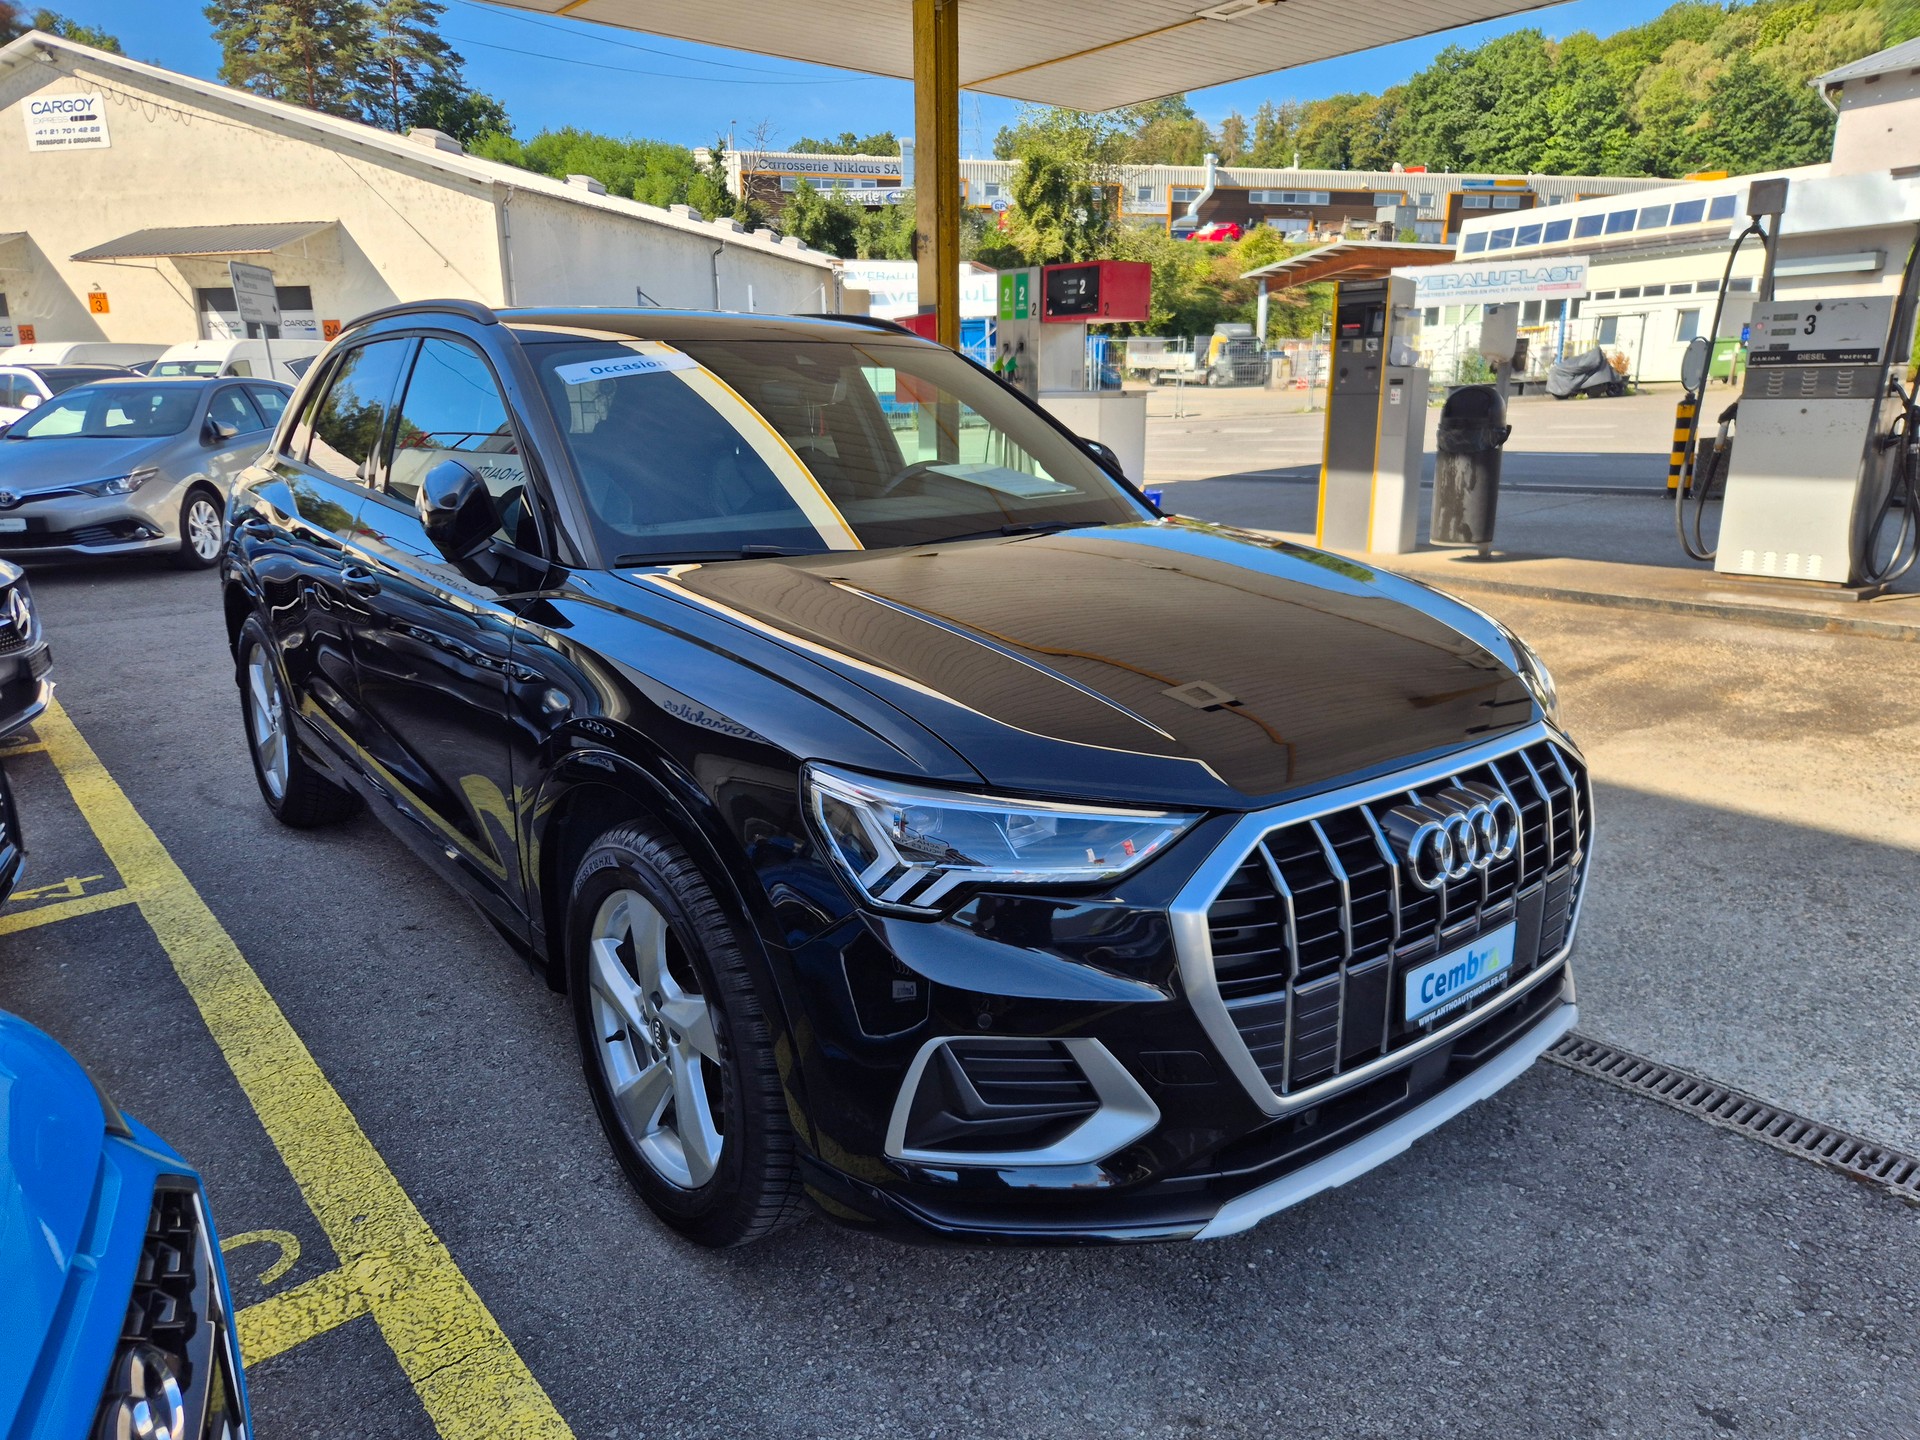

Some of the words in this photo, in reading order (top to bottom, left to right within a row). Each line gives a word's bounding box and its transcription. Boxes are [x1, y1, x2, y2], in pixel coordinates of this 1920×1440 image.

[31, 98, 95, 115] CARGOY
[36, 138, 66, 146] TRANSPORT
[759, 158, 829, 172] Carrosserie
[834, 162, 881, 174] Niklaus
[884, 164, 900, 175] SA
[1410, 265, 1583, 291] VERALUPLAST
[1019, 286, 1025, 301] 2
[1079, 279, 1086, 295] 2
[1004, 288, 1010, 302] 2
[95, 300, 103, 312] 3
[1031, 302, 1037, 316] 2
[1104, 302, 1110, 316] 2
[1803, 314, 1817, 335] 3
[20, 329, 35, 341] 3B
[590, 359, 668, 375] Occasion
